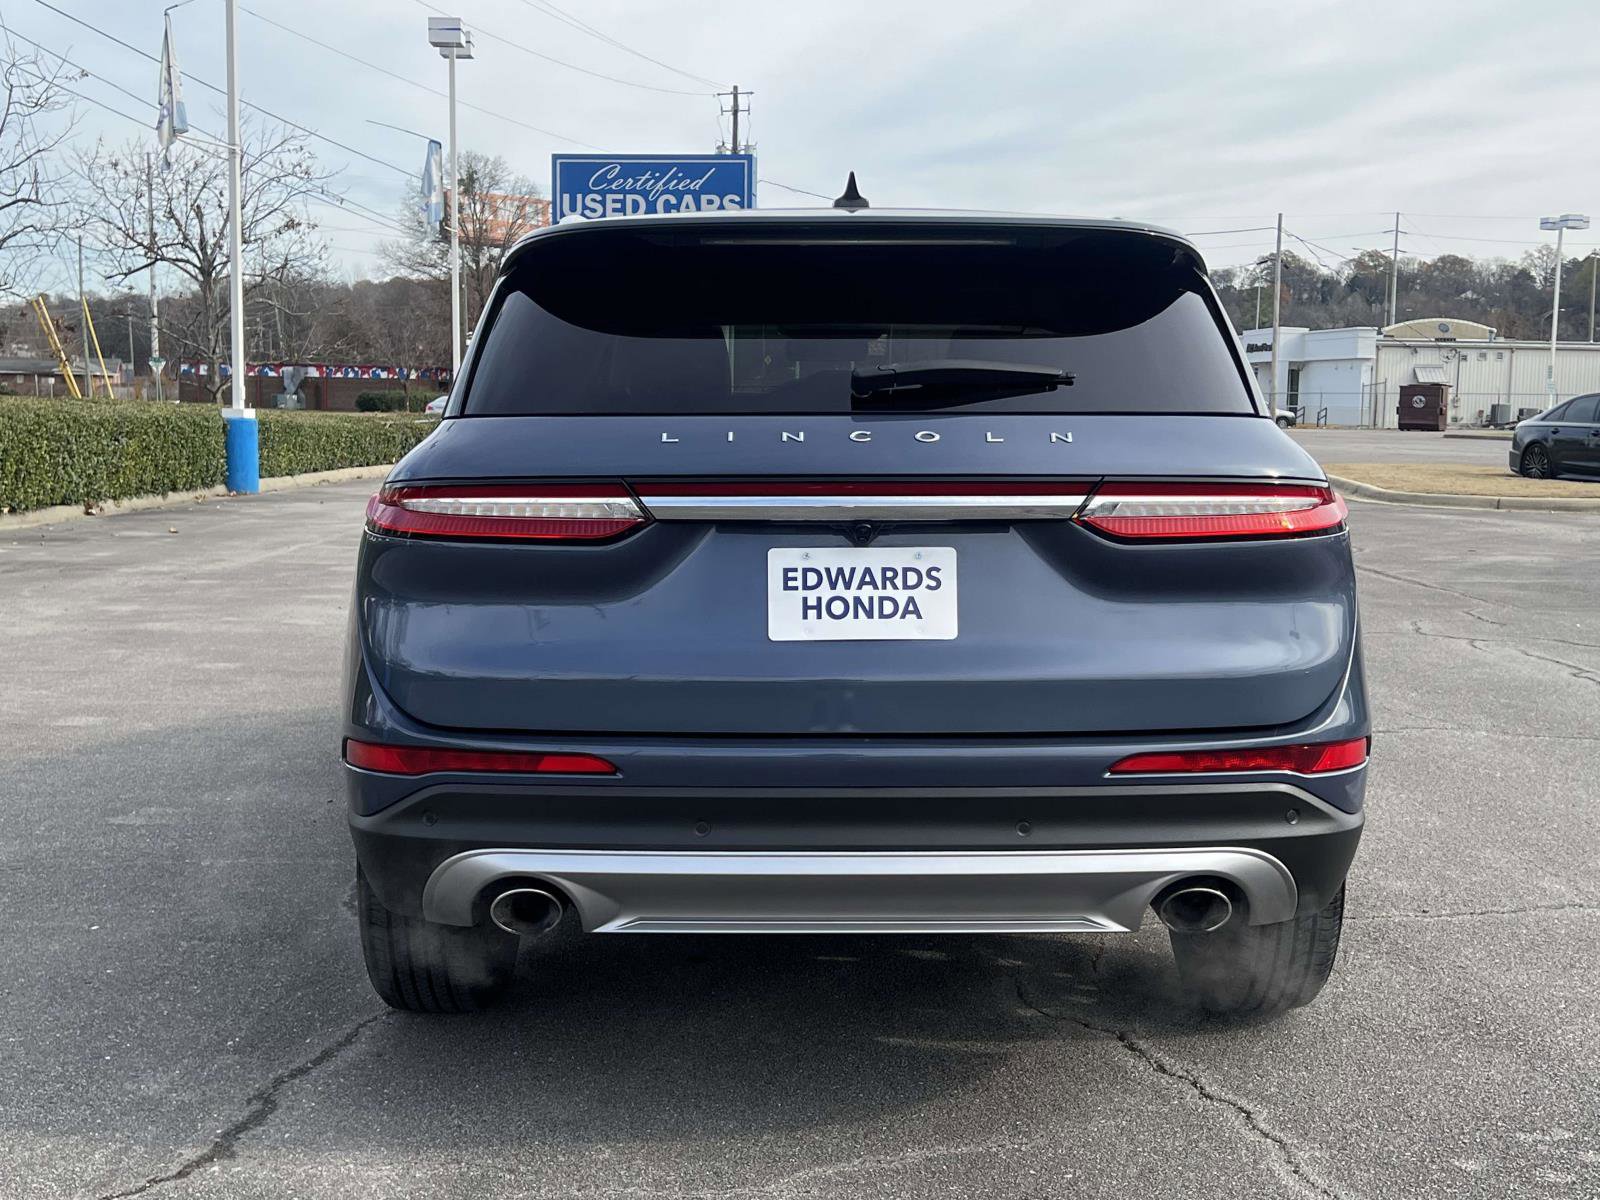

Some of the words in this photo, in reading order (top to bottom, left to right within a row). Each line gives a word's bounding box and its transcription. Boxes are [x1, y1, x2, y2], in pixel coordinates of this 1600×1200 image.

[588, 164, 716, 200] Certified
[562, 193, 647, 218] USED
[656, 194, 742, 213] CARS
[661, 430, 1073, 443] LINCOLN
[782, 566, 942, 591] EDWARDS
[801, 595, 923, 620] HONDA
